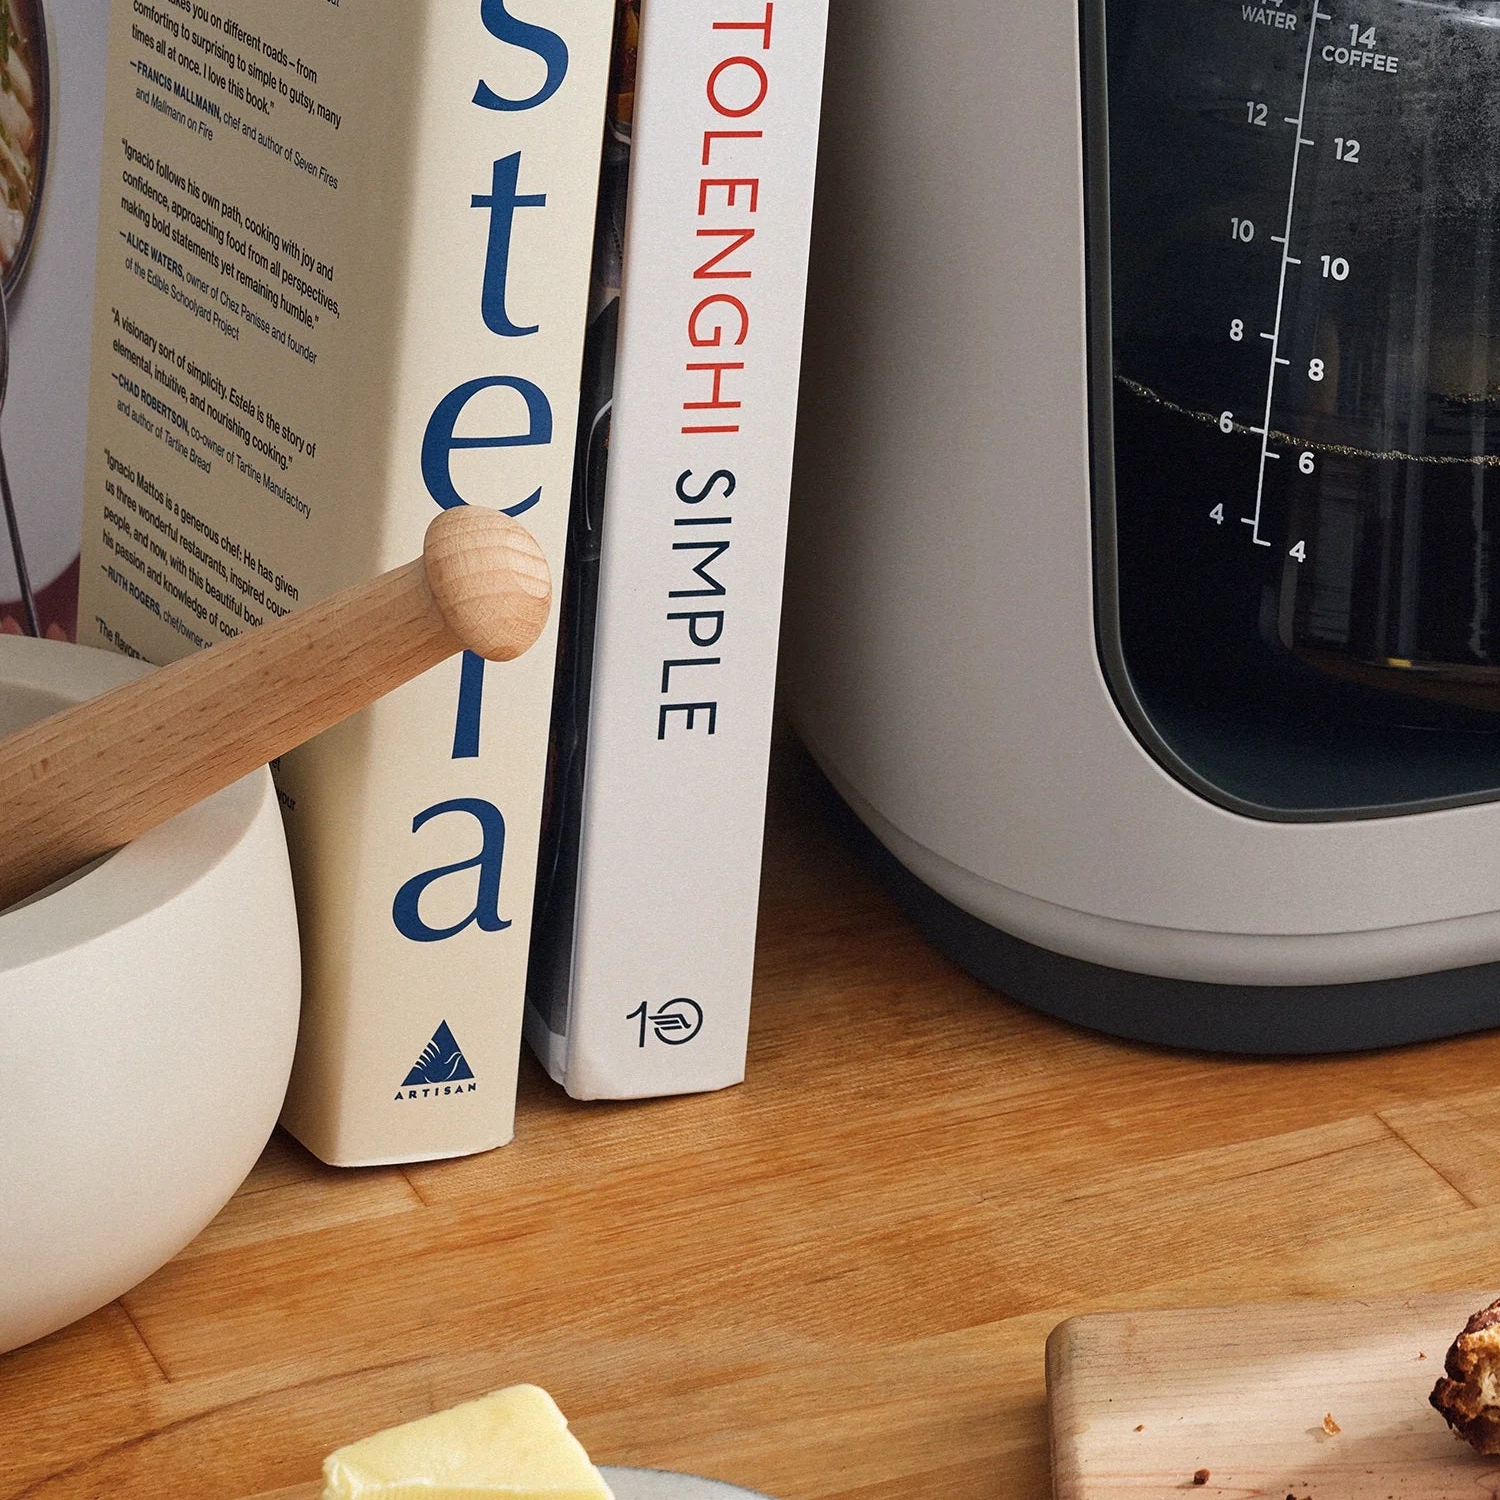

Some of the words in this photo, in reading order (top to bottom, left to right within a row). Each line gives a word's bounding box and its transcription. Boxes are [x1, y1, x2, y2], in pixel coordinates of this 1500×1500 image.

[192, 5, 209, 23] you
[210, 14, 222, 30] on
[224, 18, 261, 52] different
[1242, 3, 1296, 30] WATER
[1350, 24, 1376, 49] 14
[132, 23, 154, 49] times
[156, 39, 166, 56] all
[167, 46, 176, 62] at
[203, 63, 207, 79] I
[208, 66, 226, 89] love
[228, 78, 244, 100] this
[133, 0, 179, 38] comforting
[181, 22, 190, 41] to
[192, 32, 235, 69] surprising
[237, 53, 246, 72] to
[248, 62, 277, 89] simple
[279, 78, 288, 96] to
[317, 103, 341, 130] many
[1322, 43, 1398, 73] COFFEE
[1247, 102, 1267, 126] 12
[1334, 138, 1360, 163] 12
[156, 159, 186, 191] follows
[187, 178, 200, 199] his
[201, 191, 220, 212] own
[245, 217, 280, 251] cooking
[282, 239, 300, 261] with
[300, 248, 315, 272] joy
[316, 262, 333, 282] and
[1231, 218, 1254, 242] 10
[121, 196, 150, 228] making
[152, 213, 170, 238] bold
[172, 229, 219, 268] statements
[220, 259, 235, 278] yet
[236, 269, 278, 309] remaining
[171, 201, 224, 245] approaching
[226, 230, 246, 256] food
[248, 244, 268, 270] from
[270, 261, 281, 278] all
[1321, 255, 1349, 280] 10
[1230, 319, 1243, 341] 8
[1308, 359, 1324, 381] 8
[122, 316, 157, 353] visionary
[158, 343, 175, 364] sort
[177, 355, 186, 370] of
[229, 387, 255, 418] Estela
[257, 405, 264, 424] is
[266, 412, 280, 434] the
[281, 426, 305, 453] story
[306, 443, 316, 458] of
[190, 393, 206, 413] and
[207, 404, 250, 446] nourishing
[1220, 411, 1233, 433] 6
[1299, 452, 1314, 474] 6
[1209, 503, 1224, 524] 4
[105, 480, 115, 496] us
[116, 485, 137, 512] three
[138, 504, 178, 543] wonderful
[230, 567, 264, 605] inspired
[136, 472, 164, 504] Mattos
[165, 492, 172, 511] is
[174, 503, 179, 516] a
[180, 508, 219, 544] generous
[244, 549, 256, 570] He
[258, 559, 273, 583] has
[275, 575, 298, 601] given
[1289, 540, 1306, 562] 4
[103, 528, 114, 550] his
[115, 542, 145, 574] passion
[147, 566, 162, 586] and
[163, 574, 207, 620] knowledge
[209, 612, 218, 627] of
[133, 527, 149, 548] and
[170, 554, 187, 577] with
[189, 566, 204, 589] this
[205, 578, 242, 618] beautiful
[658, 469, 736, 740] SIMPLE
[394, 1082, 476, 1100] ARTISAN
